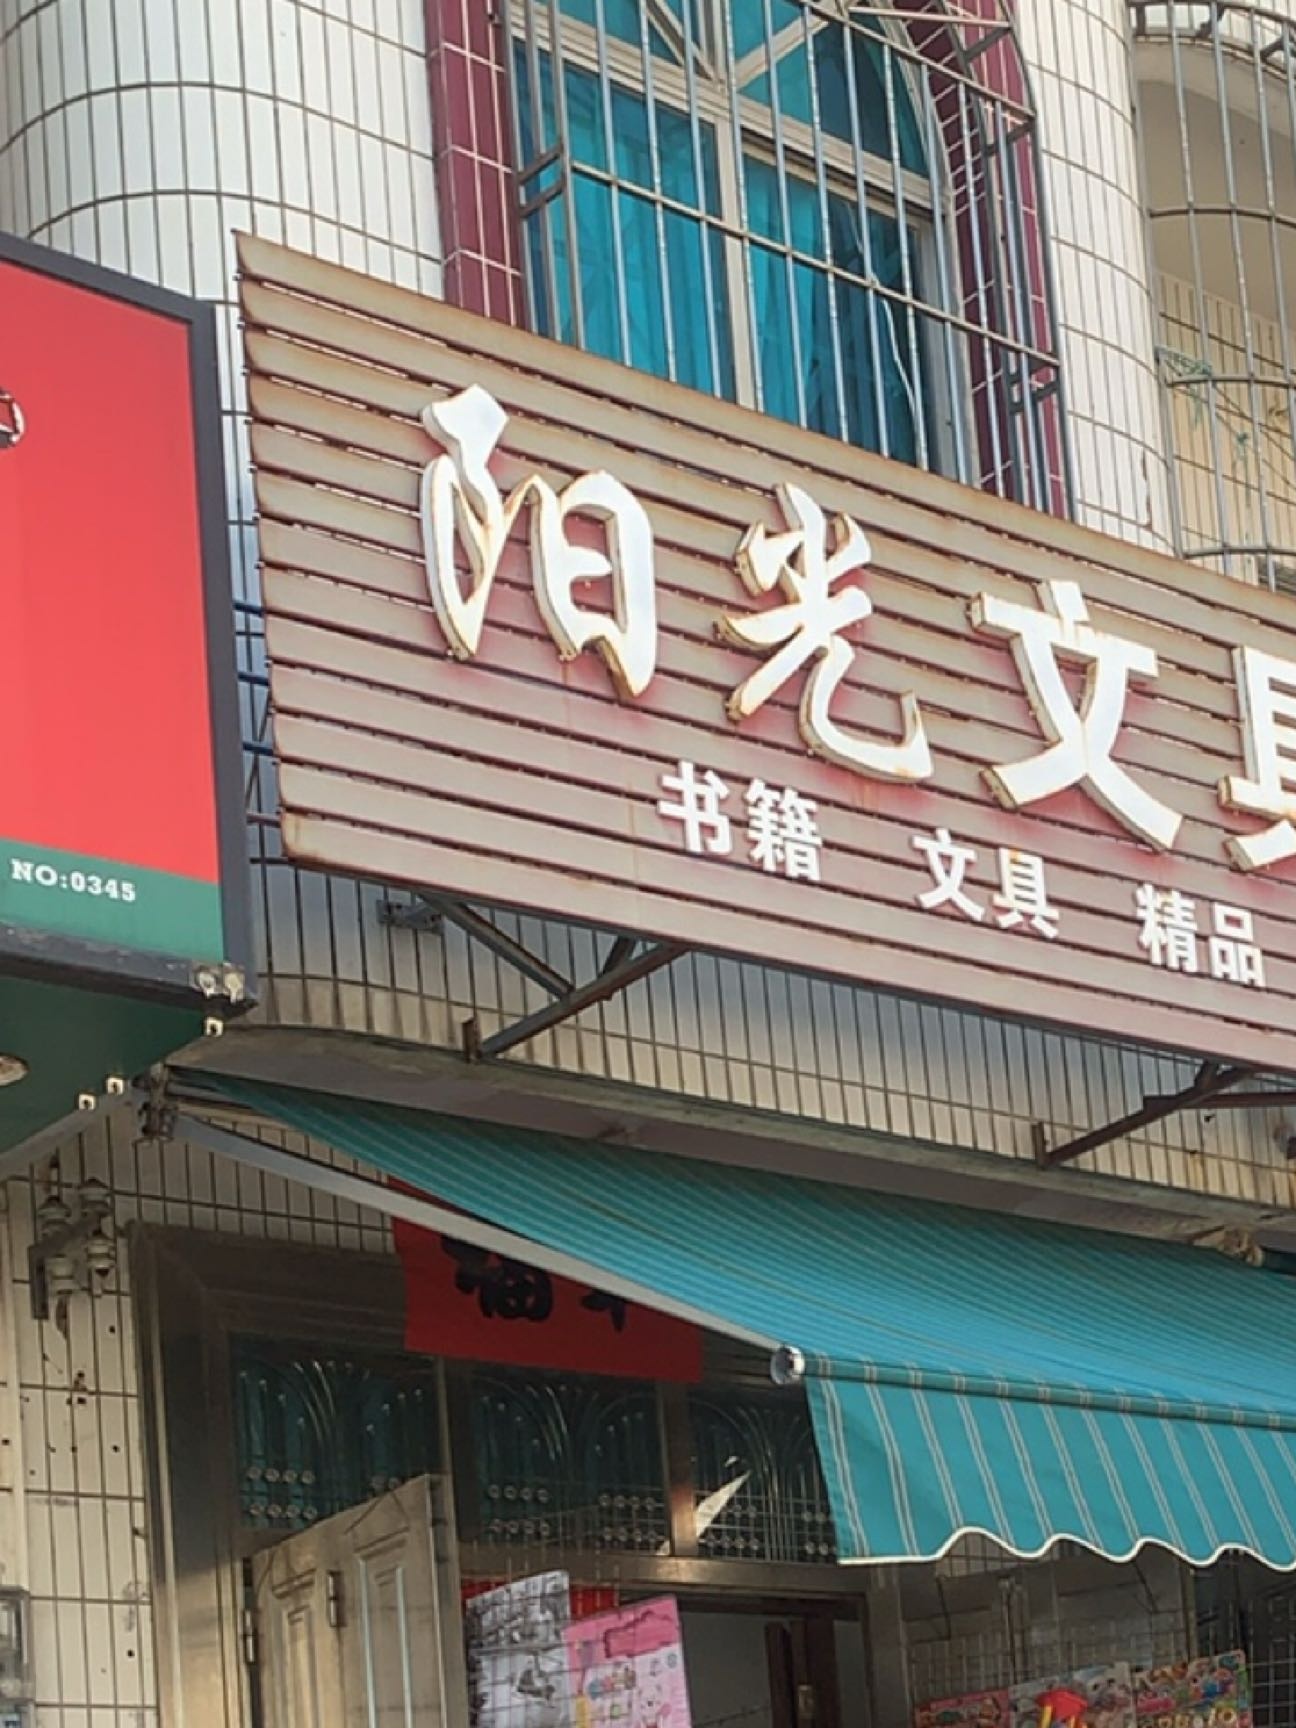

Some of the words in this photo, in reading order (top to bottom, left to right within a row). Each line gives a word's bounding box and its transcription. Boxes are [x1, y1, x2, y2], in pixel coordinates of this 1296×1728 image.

[10, 858, 136, 902] NO:0345
[656, 759, 823, 882] 书籍
[911, 827, 1060, 939] 文具
[1133, 883, 1267, 988] 精品
